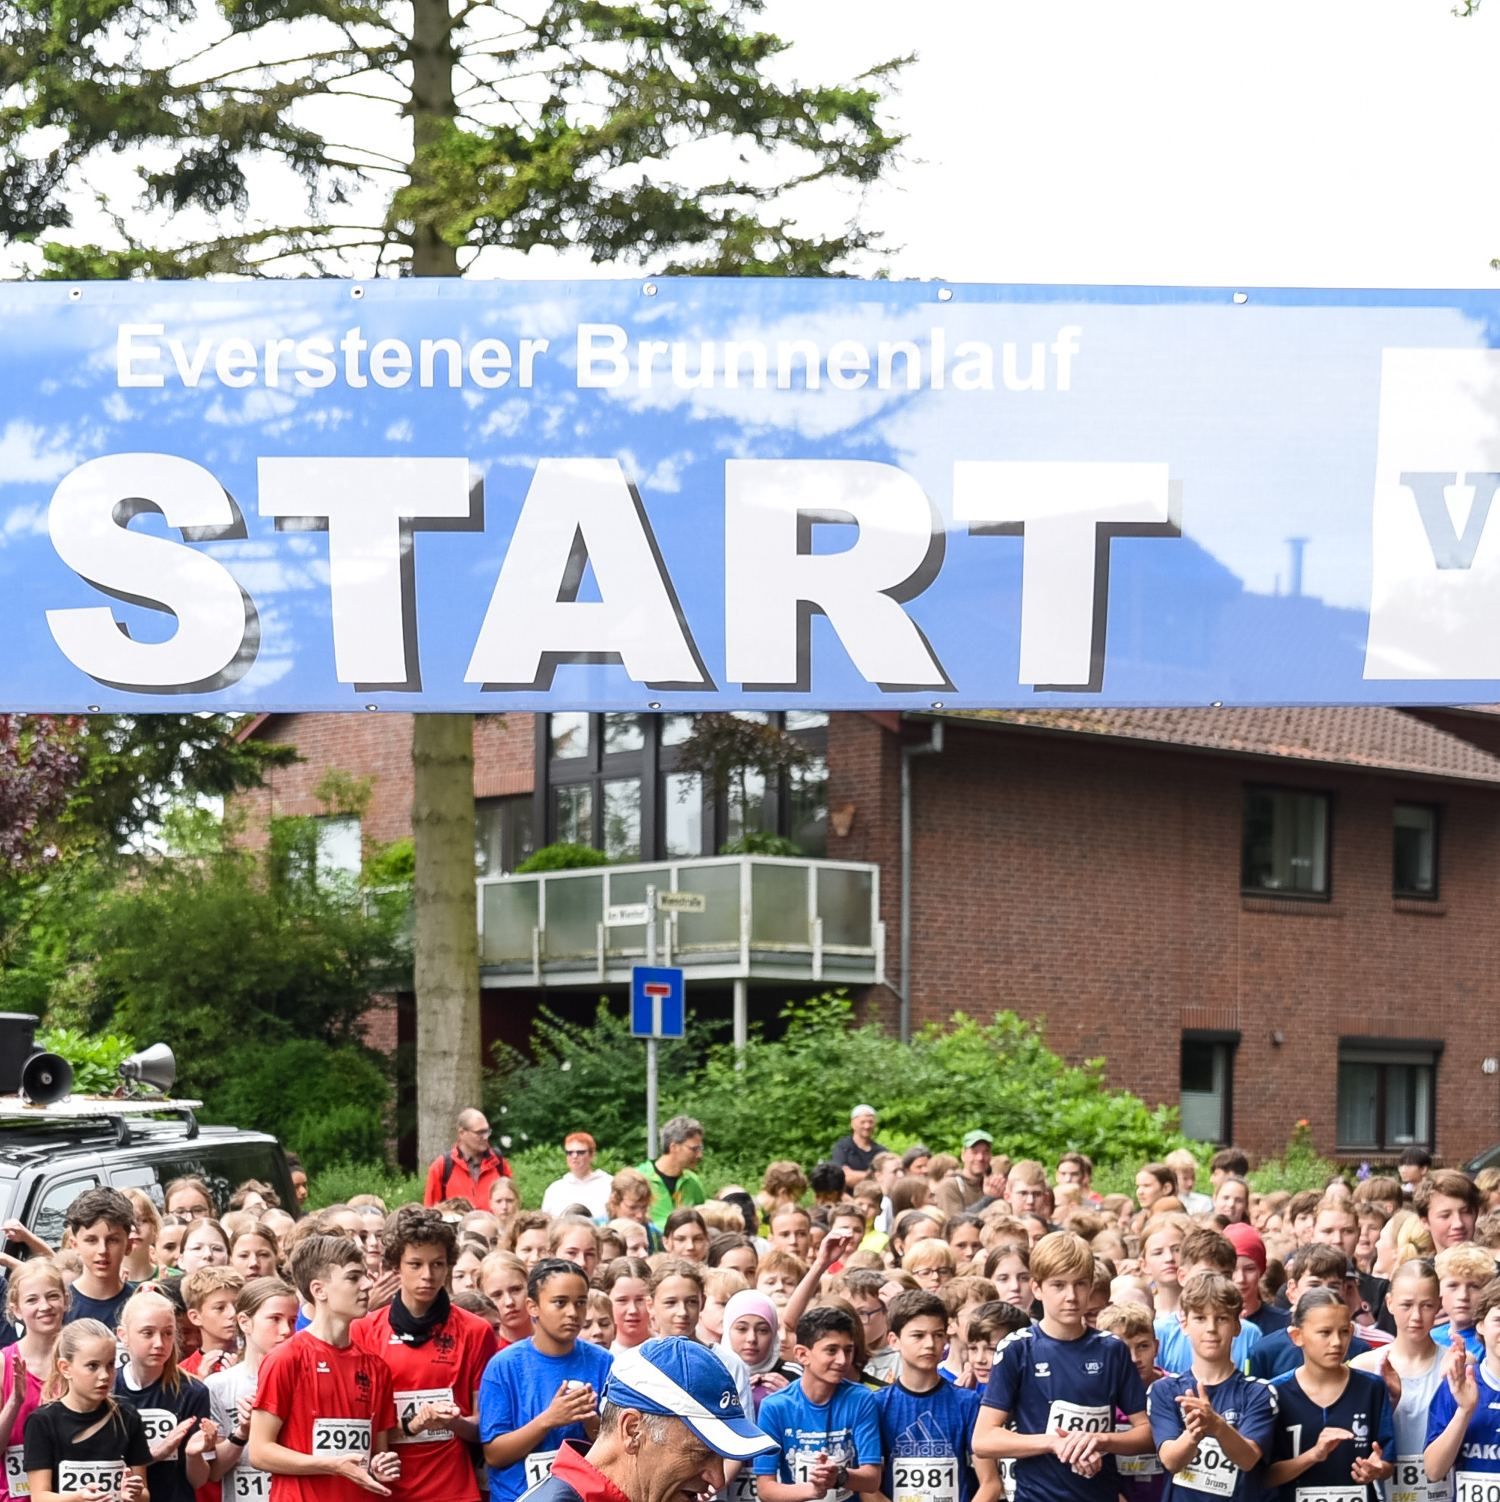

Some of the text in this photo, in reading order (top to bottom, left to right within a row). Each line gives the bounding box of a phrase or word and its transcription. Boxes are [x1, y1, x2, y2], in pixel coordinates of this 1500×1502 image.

[114, 320, 1083, 394] Everstener Brunnenlauf
[45, 451, 1182, 692] START
[1053, 1413, 1109, 1433] 1802
[316, 1430, 371, 1450] 2920
[62, 1472, 125, 1493] 2958
[895, 1468, 954, 1488] 2981
[1205, 1477, 1228, 1490] bruns
[1392, 1492, 1418, 1501] EWE
